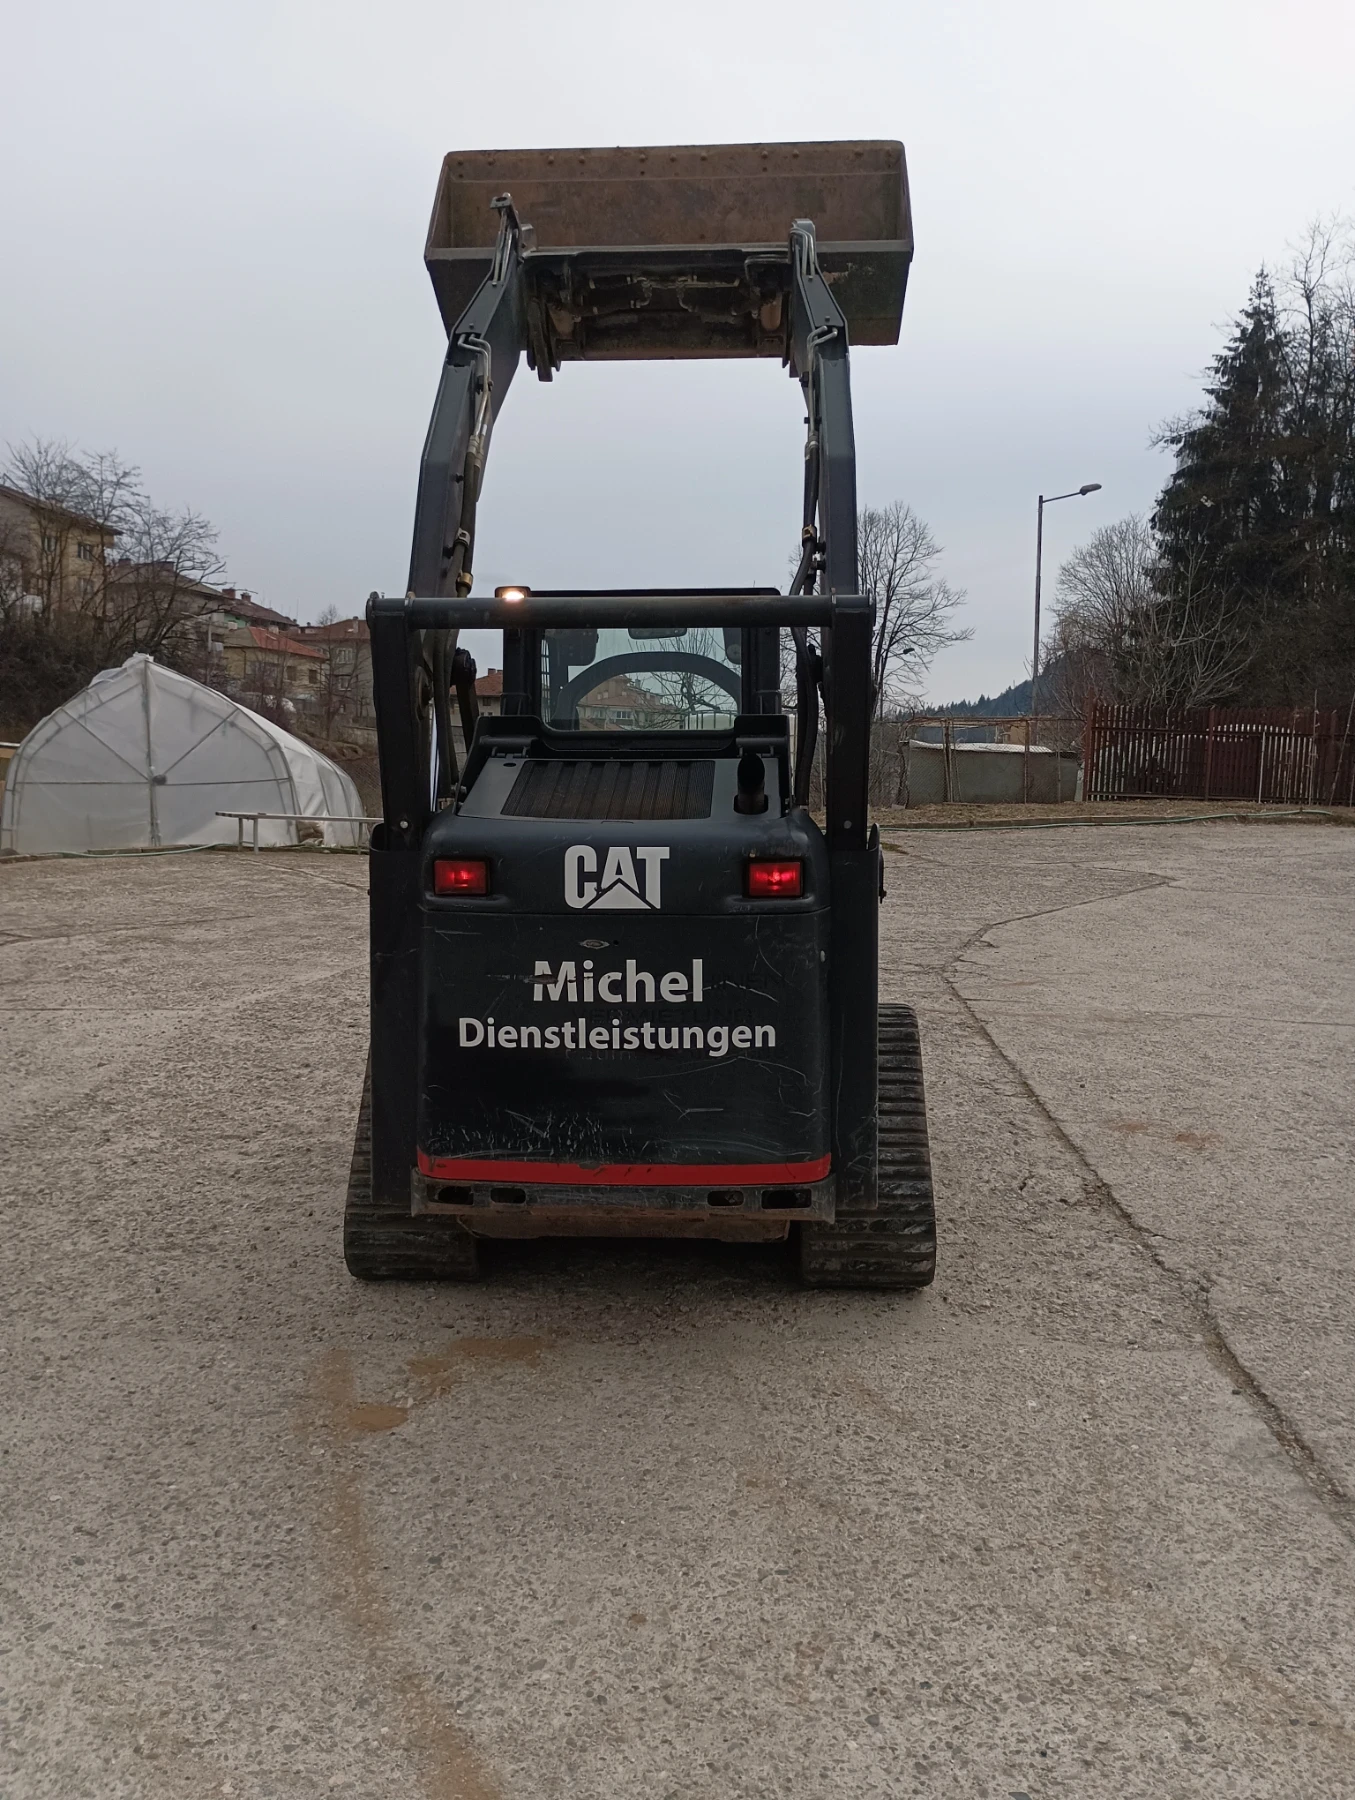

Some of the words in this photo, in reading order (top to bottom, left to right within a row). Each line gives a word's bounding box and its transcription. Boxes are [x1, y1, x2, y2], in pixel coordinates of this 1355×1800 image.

[564, 844, 670, 910] CAT
[533, 958, 703, 1003] Michel
[458, 1017, 776, 1057] Dienstleistungen
